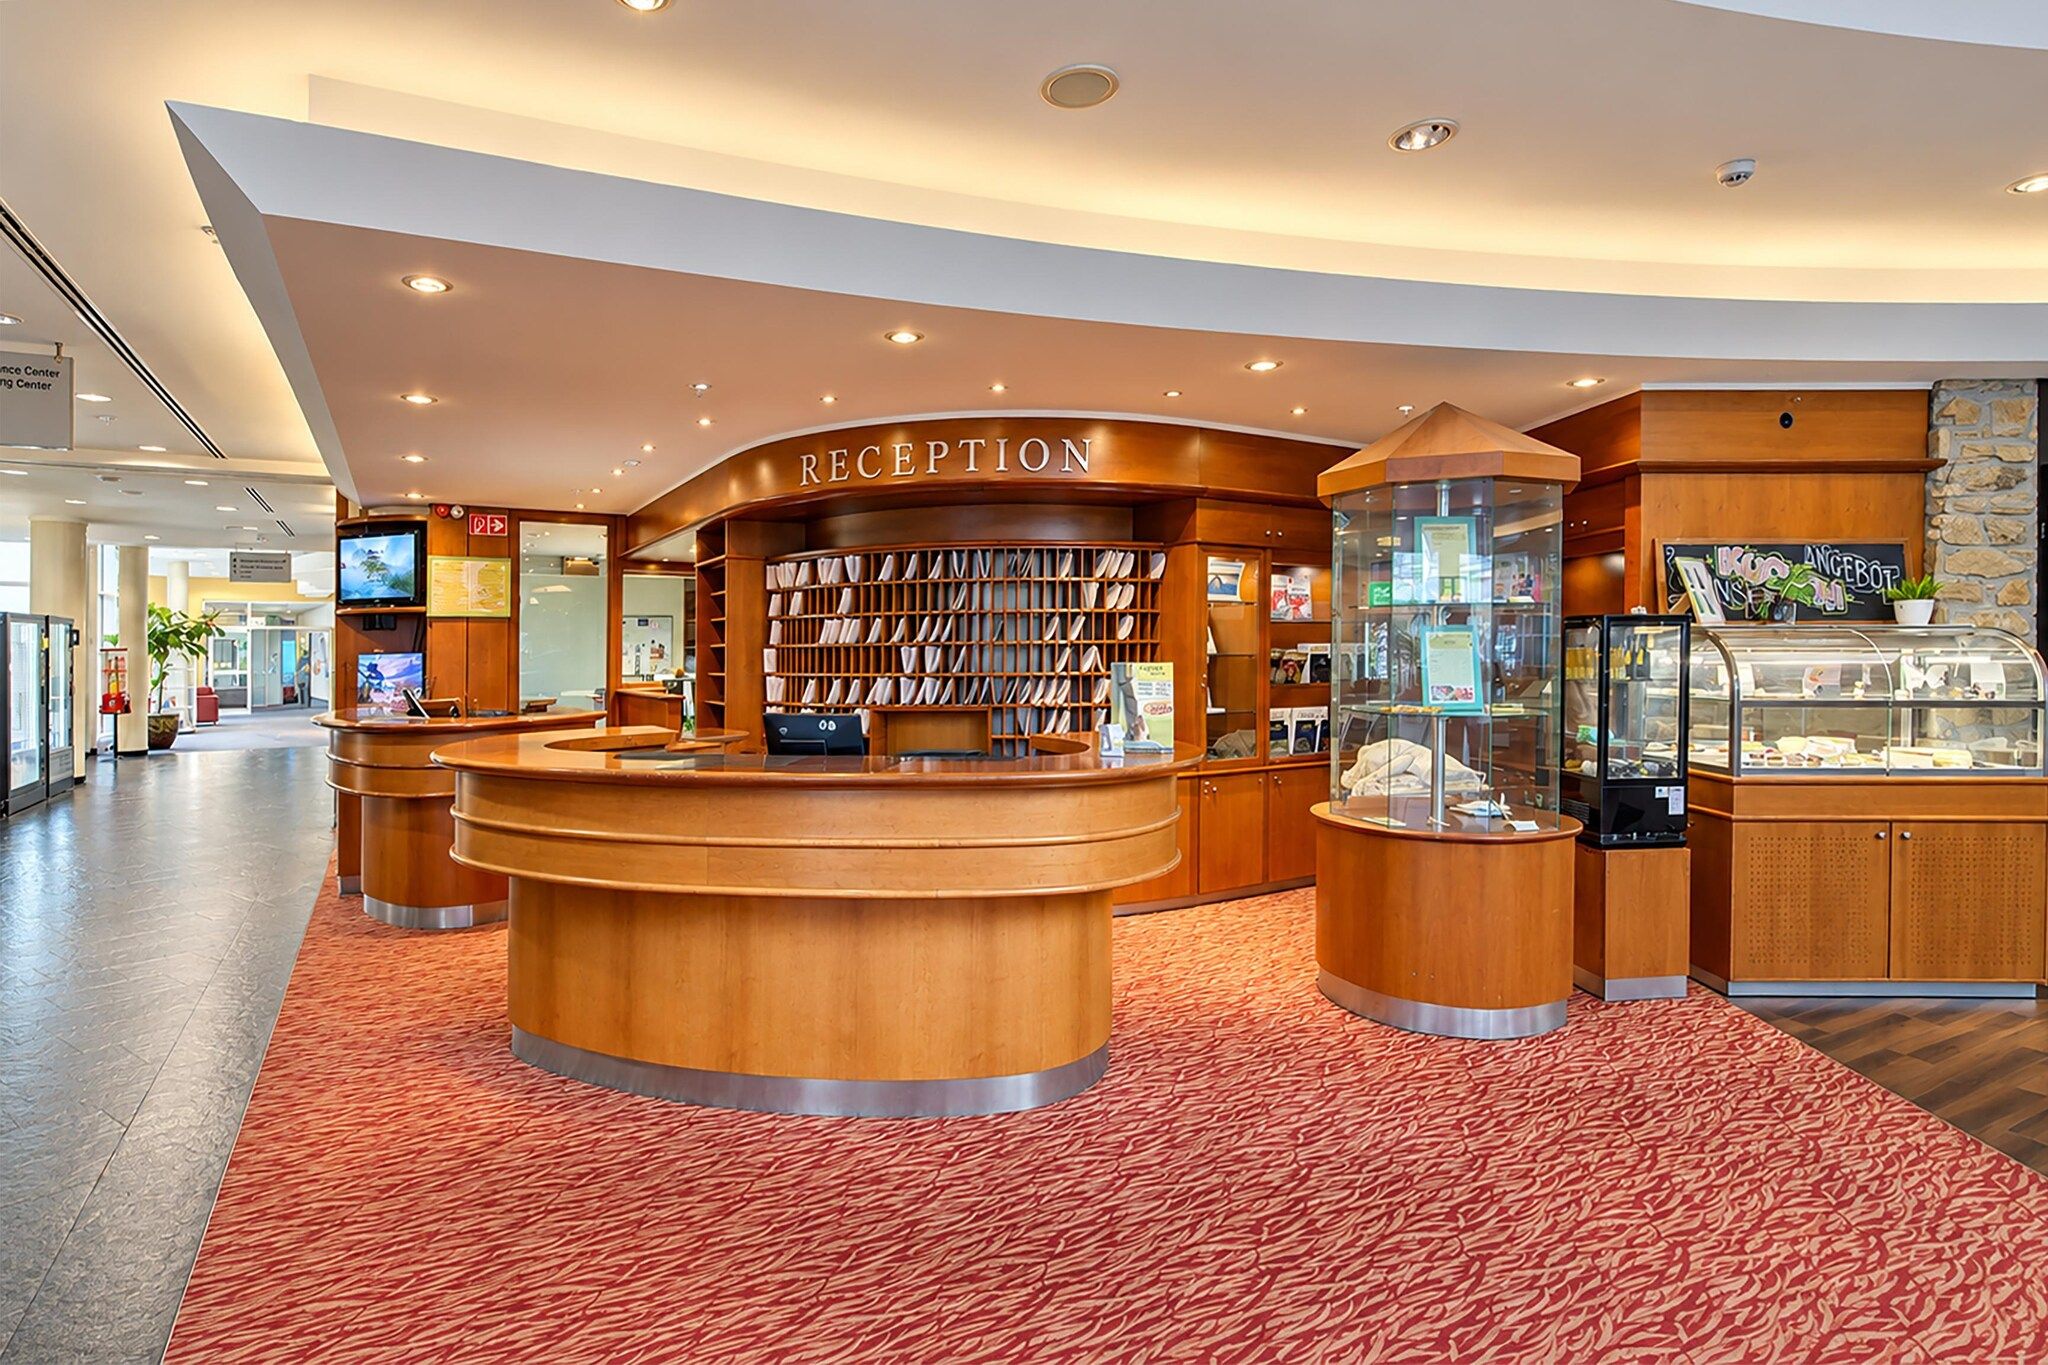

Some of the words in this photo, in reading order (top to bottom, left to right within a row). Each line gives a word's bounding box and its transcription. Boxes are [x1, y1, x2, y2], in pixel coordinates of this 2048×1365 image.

[16, 379, 52, 390] Center
[24, 366, 60, 378] Center
[800, 438, 1091, 486] RECEPTION
[1803, 545, 1898, 591] ANGEBOT
